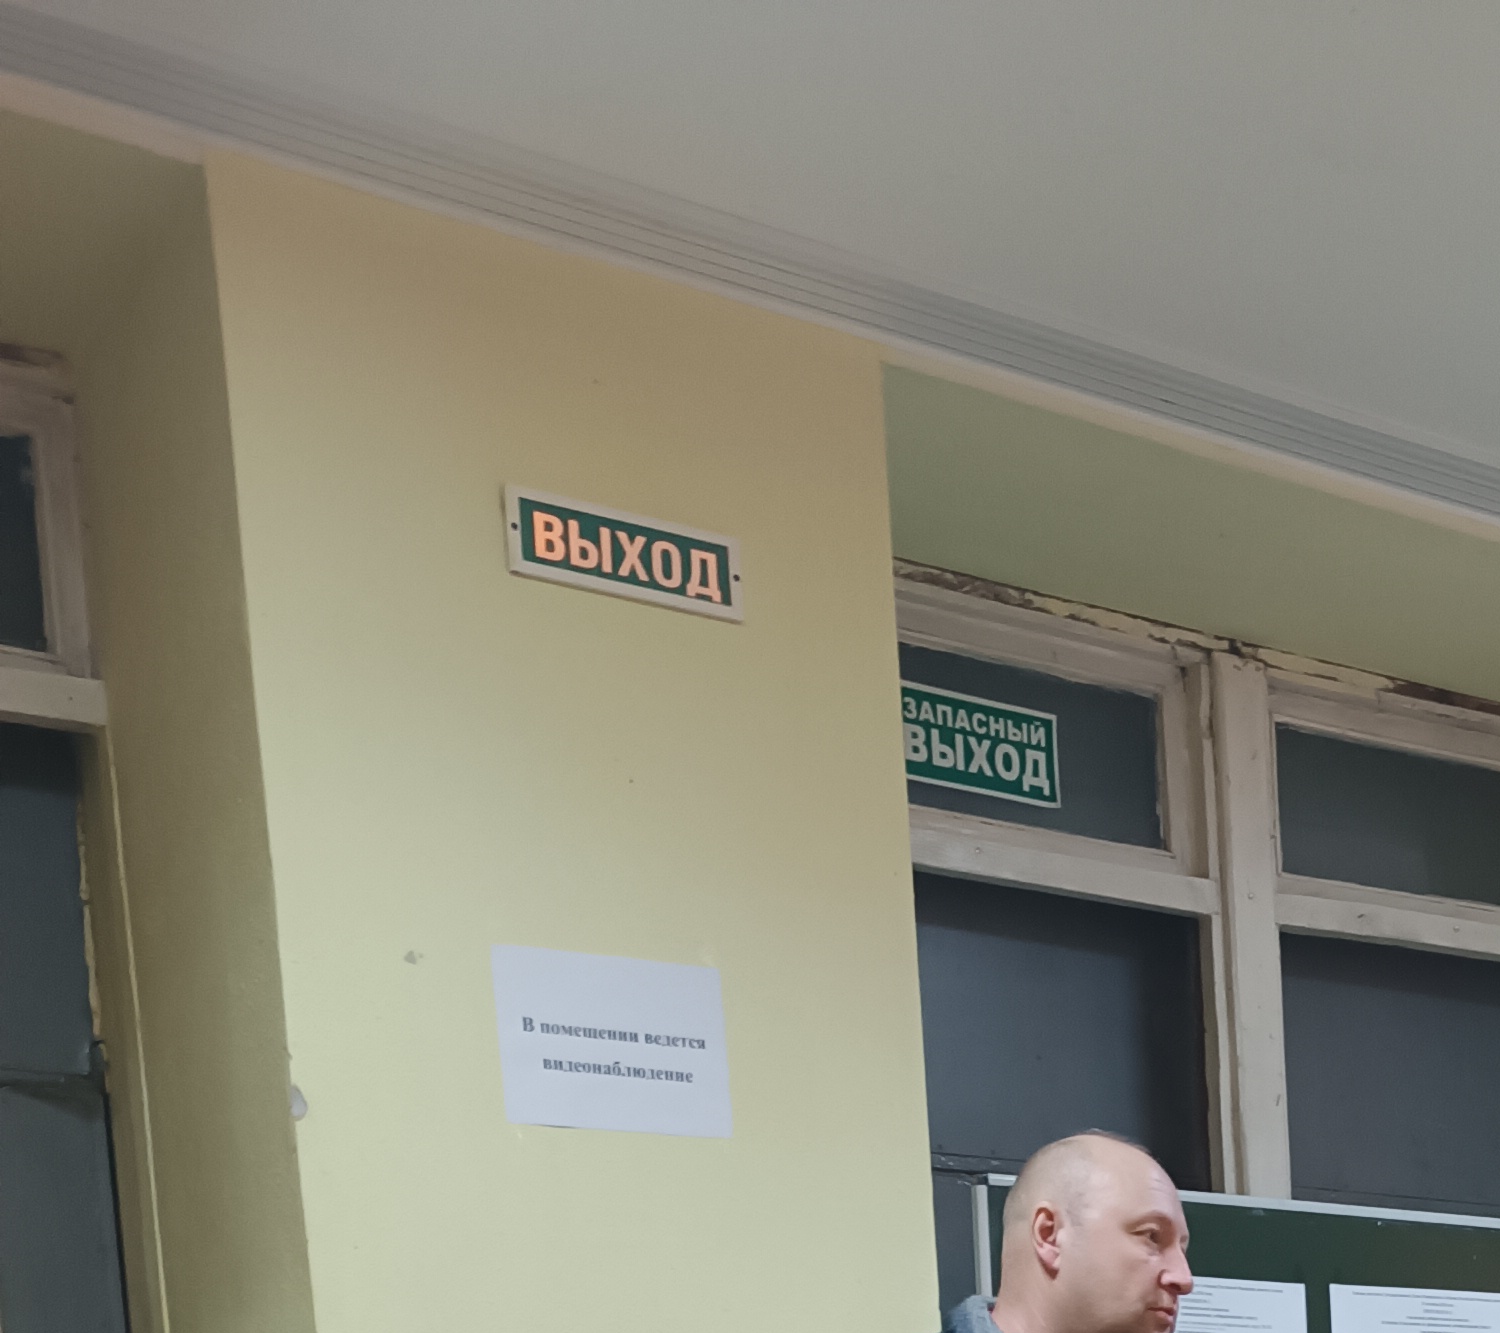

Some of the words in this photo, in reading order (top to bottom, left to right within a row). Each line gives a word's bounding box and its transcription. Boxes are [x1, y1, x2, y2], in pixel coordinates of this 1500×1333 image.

[532, 510, 722, 604] ВЫХОД
[902, 696, 1046, 747] ЗАПАСНЫЙ
[902, 722, 1050, 796] ВЫХОД
[521, 1016, 535, 1033] В
[539, 1021, 640, 1043] помещении
[644, 1032, 706, 1050] ведется
[542, 1057, 694, 1084] видеонаблюдение
